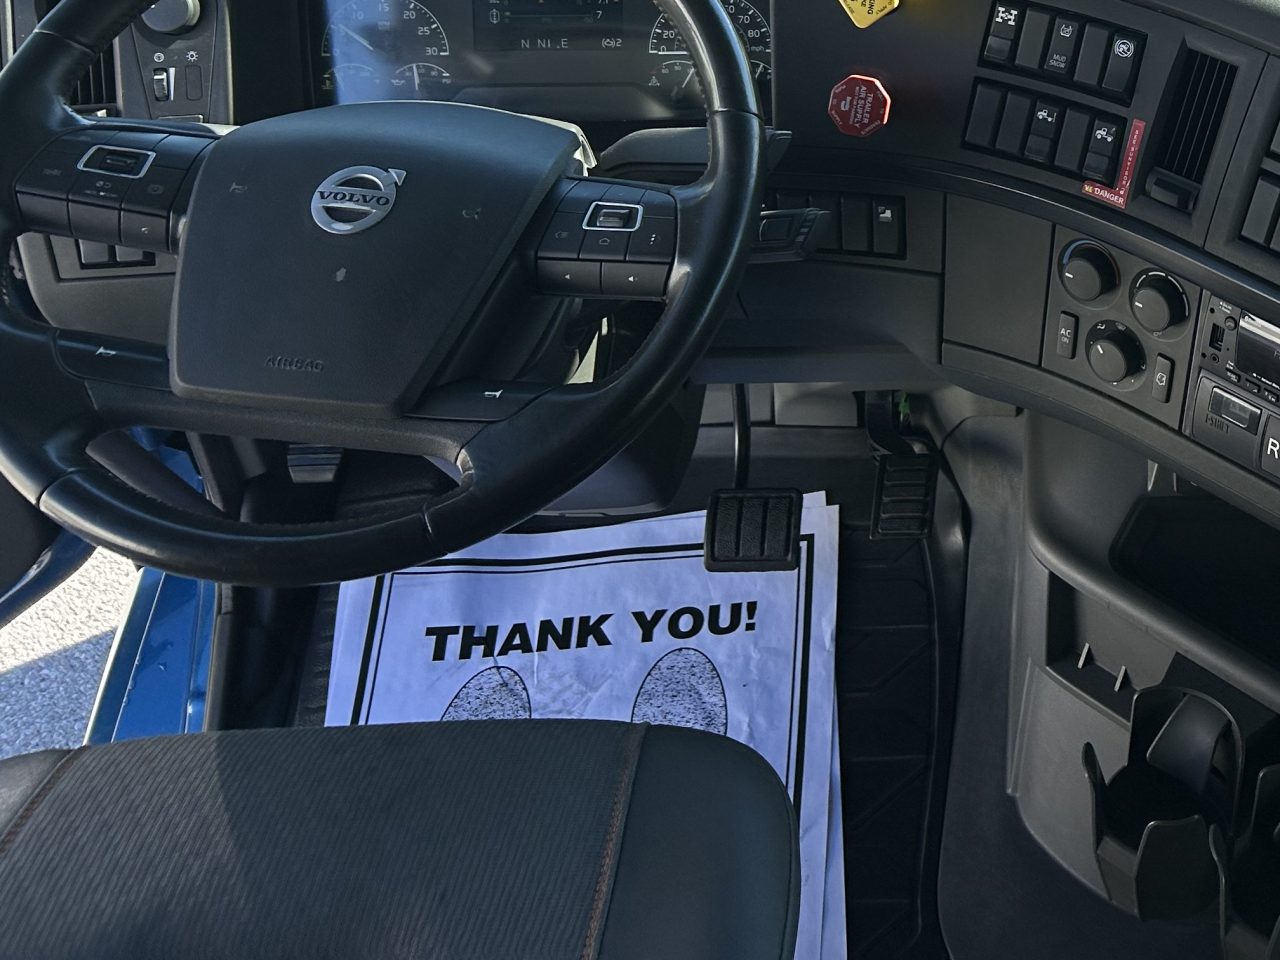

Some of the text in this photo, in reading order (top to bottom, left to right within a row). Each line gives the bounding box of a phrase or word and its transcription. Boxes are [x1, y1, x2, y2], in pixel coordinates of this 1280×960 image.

[378, 3, 390, 12] 15
[352, 11, 365, 20] 10
[403, 10, 416, 19] 20
[738, 15, 751, 25] 70
[417, 26, 431, 36] 25
[662, 30, 675, 39] 20
[747, 29, 761, 38] 80
[425, 47, 438, 56] 30
[854, 98, 865, 129] SUPPLY
[861, 93, 874, 124] TRAILER
[317, 190, 390, 206] VOLVO
[1094, 187, 1125, 205] DANGER
[1060, 327, 1072, 338] AC
[264, 355, 324, 372] AIRBAG
[1267, 437, 1280, 459] R
[424, 600, 758, 662] THANK YOU!
